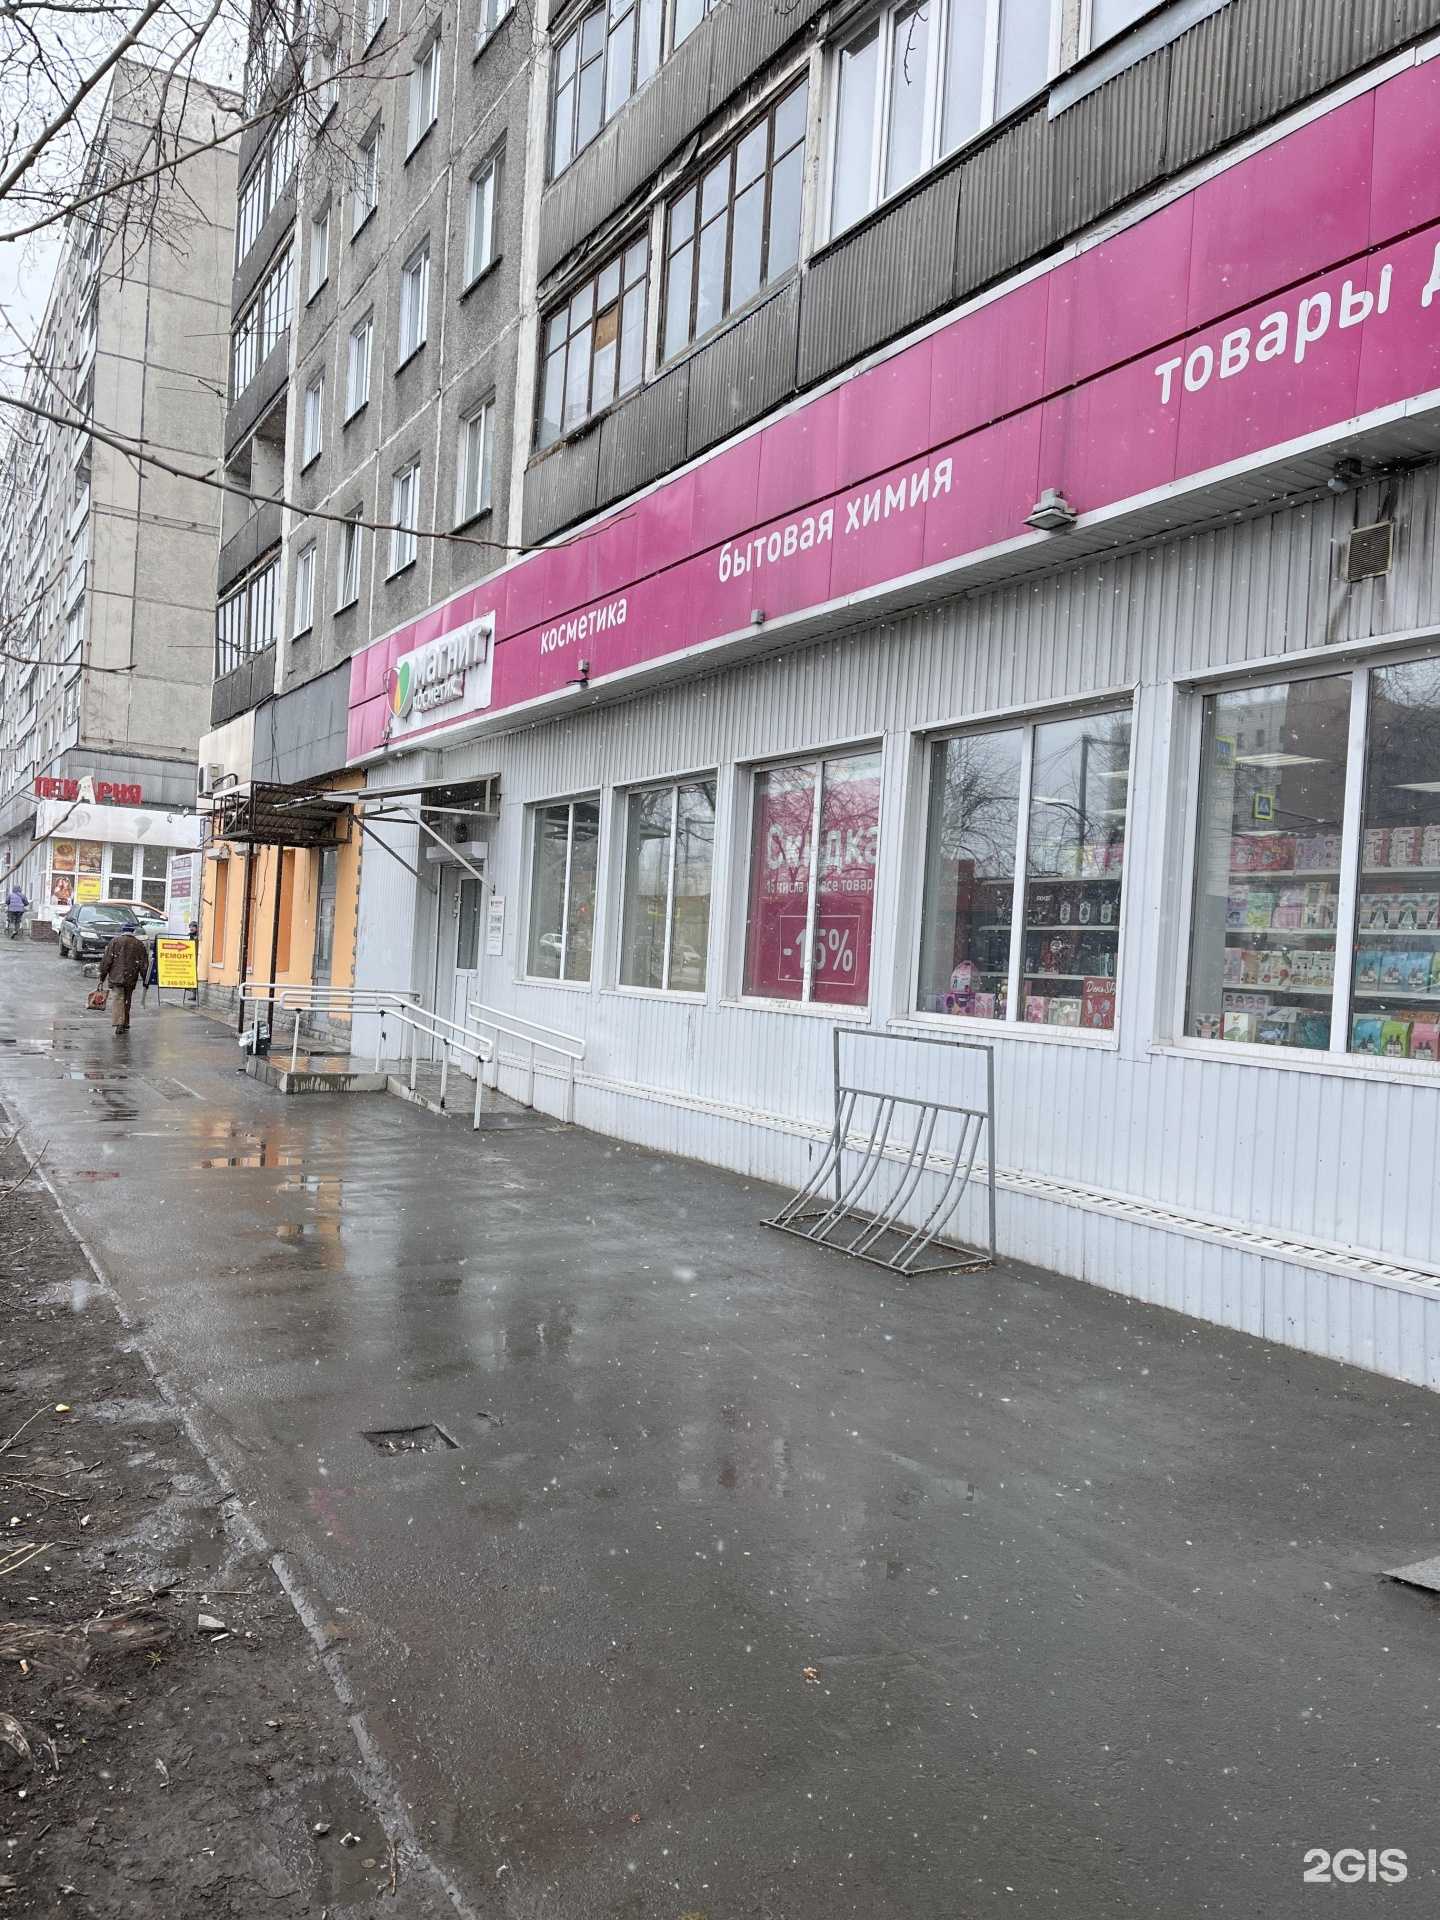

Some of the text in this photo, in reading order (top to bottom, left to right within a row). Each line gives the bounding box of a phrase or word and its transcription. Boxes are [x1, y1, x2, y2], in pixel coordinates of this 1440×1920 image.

[1154, 263, 1393, 405] товары
[718, 458, 953, 583] бытовая химия
[540, 598, 627, 655] косметика
[34, 775, 143, 805] ПЕКАРНЯ
[776, 880, 804, 894] числа
[159, 952, 193, 960] РЕМОНТ
[783, 928, 853, 972] -15%
